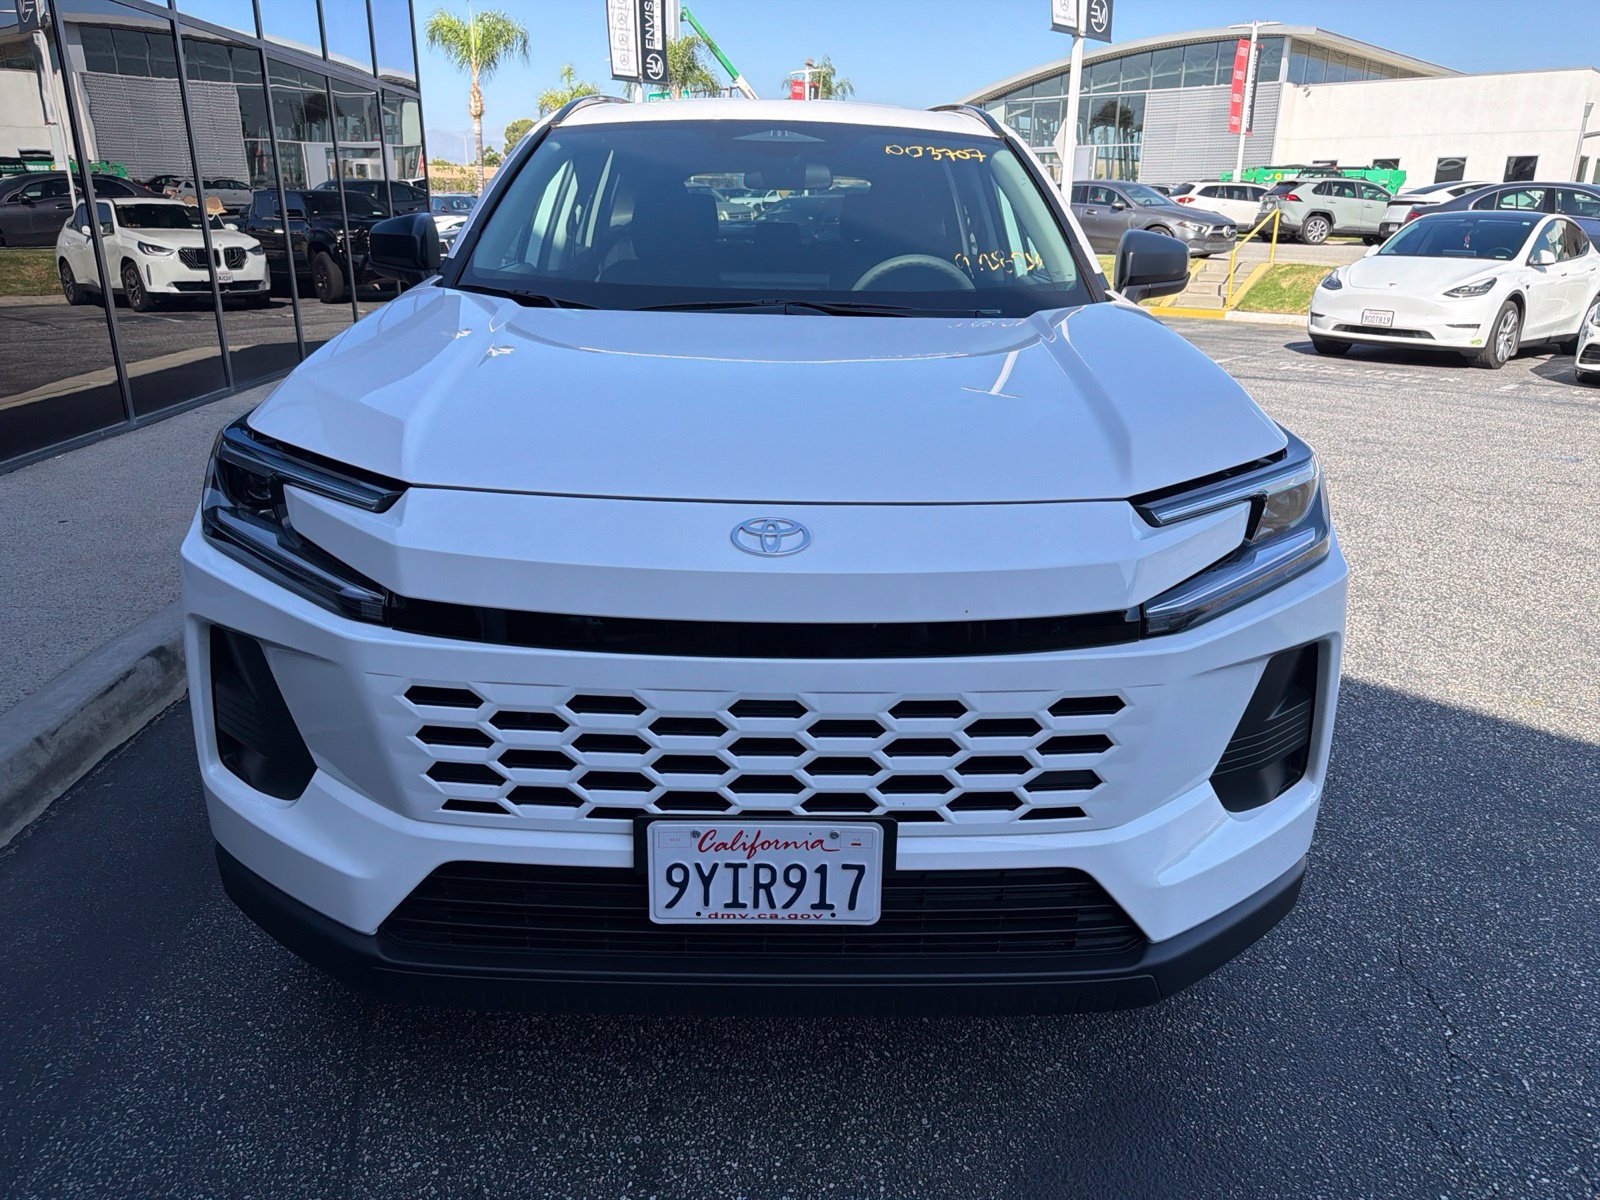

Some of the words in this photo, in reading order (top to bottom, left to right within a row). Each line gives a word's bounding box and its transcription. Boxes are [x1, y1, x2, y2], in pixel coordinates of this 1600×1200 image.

[697, 829, 841, 860] California
[664, 862, 867, 911] 9YIR917
[707, 911, 825, 921] dmv.ca.gov
